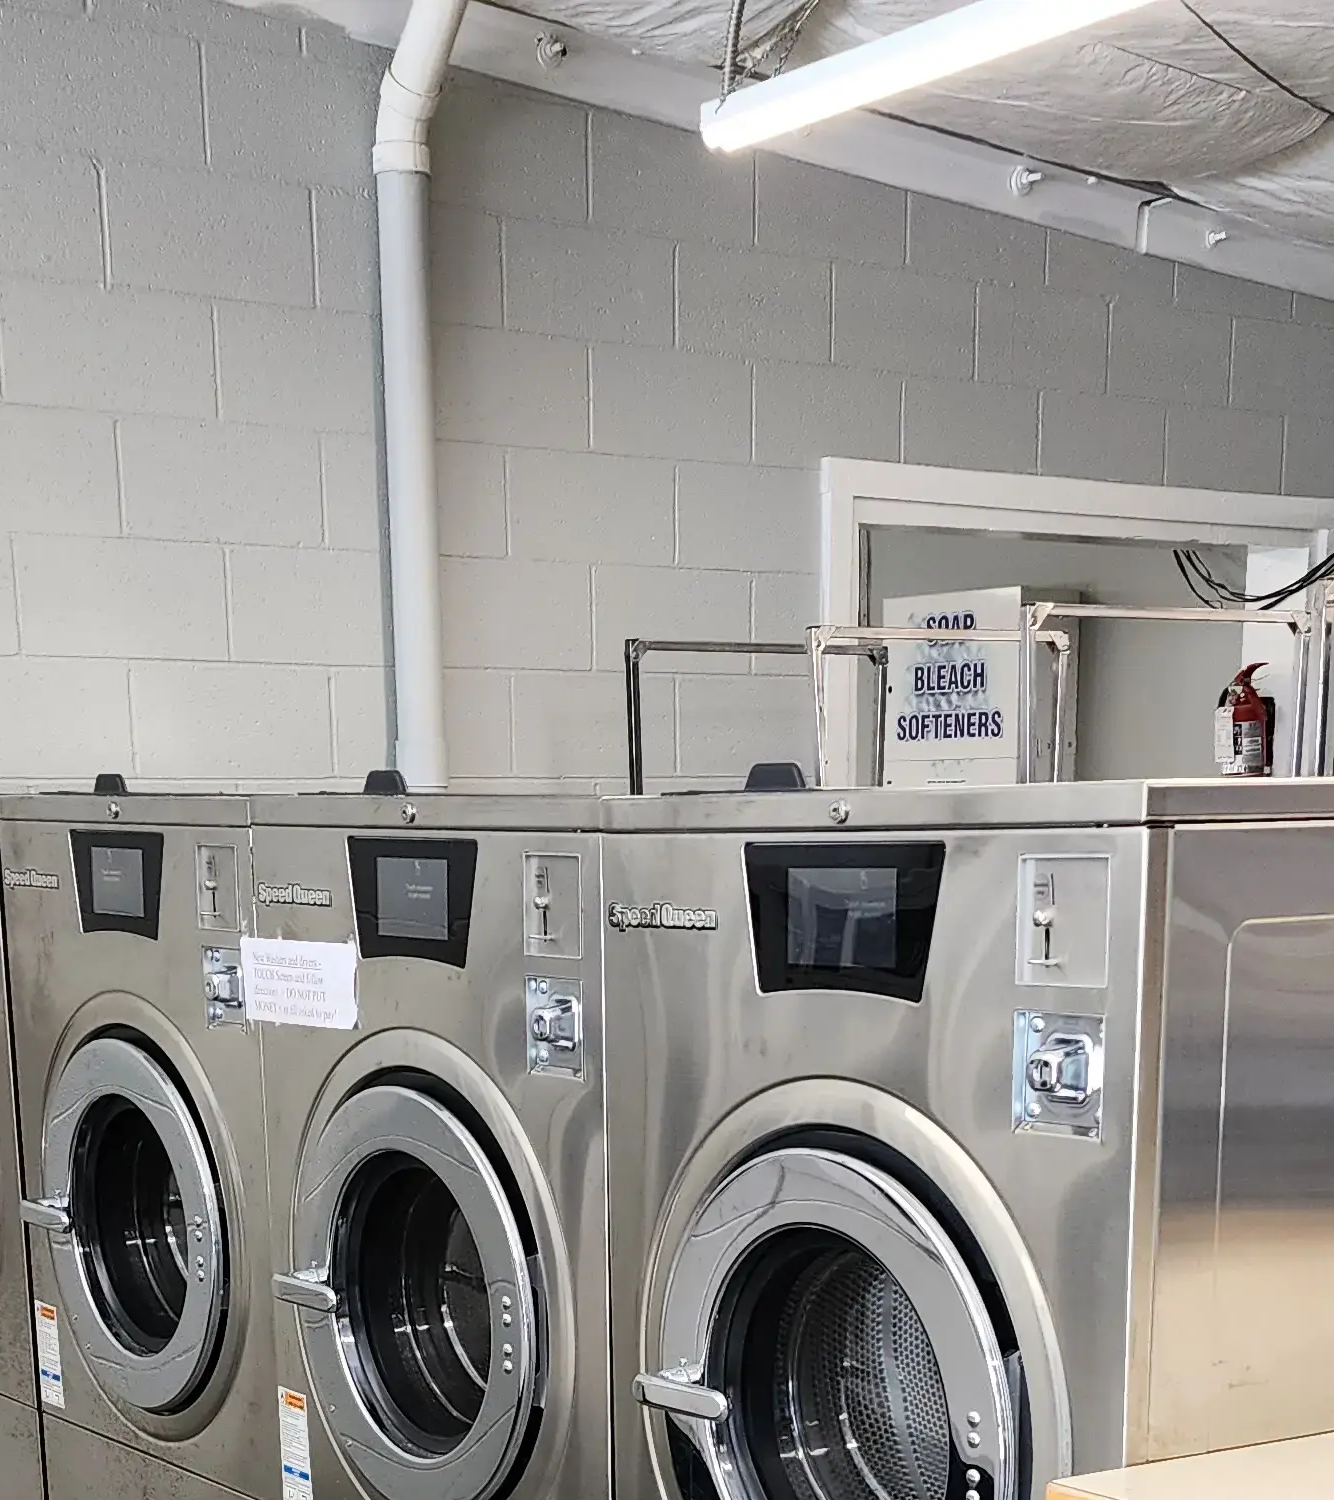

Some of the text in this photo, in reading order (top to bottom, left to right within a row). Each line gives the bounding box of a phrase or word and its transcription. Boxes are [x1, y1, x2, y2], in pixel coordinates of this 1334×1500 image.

[913, 662, 986, 692] BLEACH
[897, 710, 1004, 741] SOFTENERS
[4, 868, 59, 889] Speed Queen
[258, 882, 332, 907] Speed Queen
[609, 902, 718, 932] Speed Queen
[297, 989, 310, 1001] NOT
